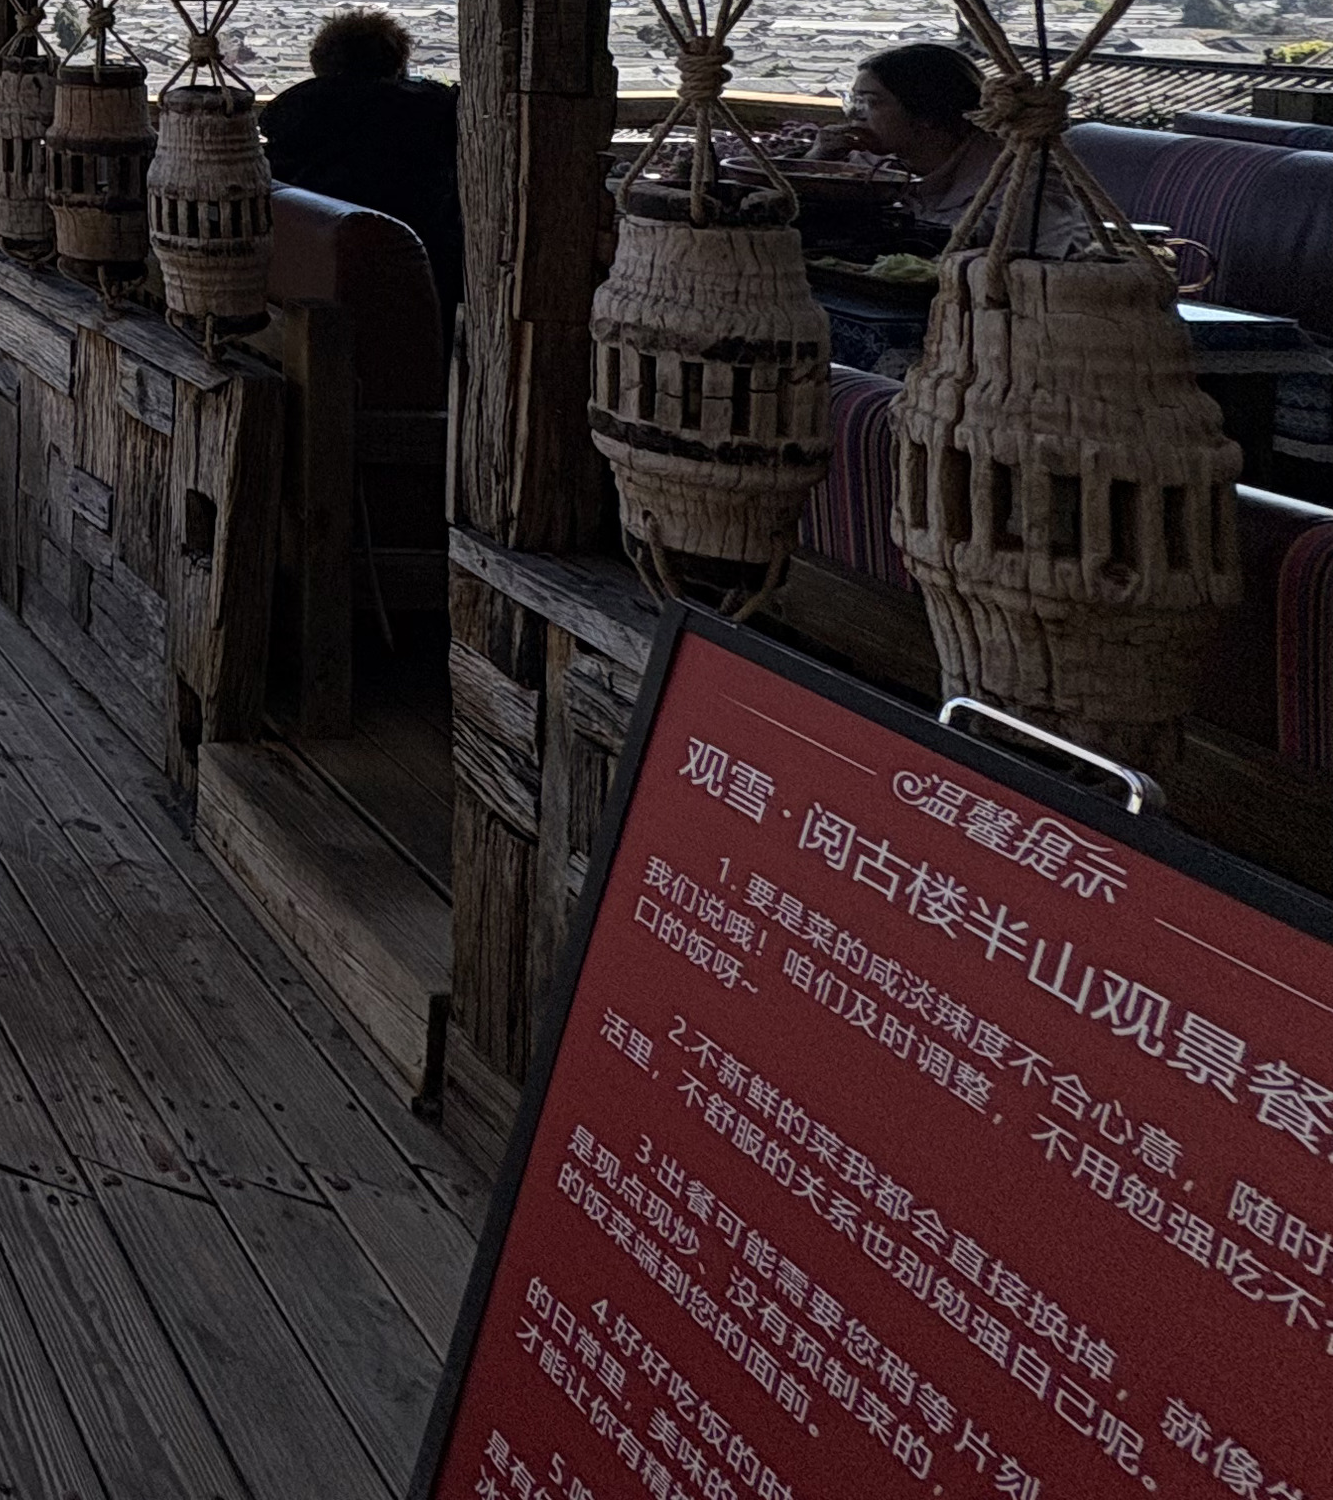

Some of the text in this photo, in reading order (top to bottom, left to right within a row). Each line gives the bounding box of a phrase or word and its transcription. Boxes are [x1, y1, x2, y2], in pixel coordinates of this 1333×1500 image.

[678, 736, 1333, 1163] 观雪·阅古楼半山观景餐
[892, 769, 1128, 904] 温馨提示
[642, 855, 1333, 1356] 我们说哦！咱们及时调整，不用勉强吃不
[484, 1428, 552, 1500] 是有
